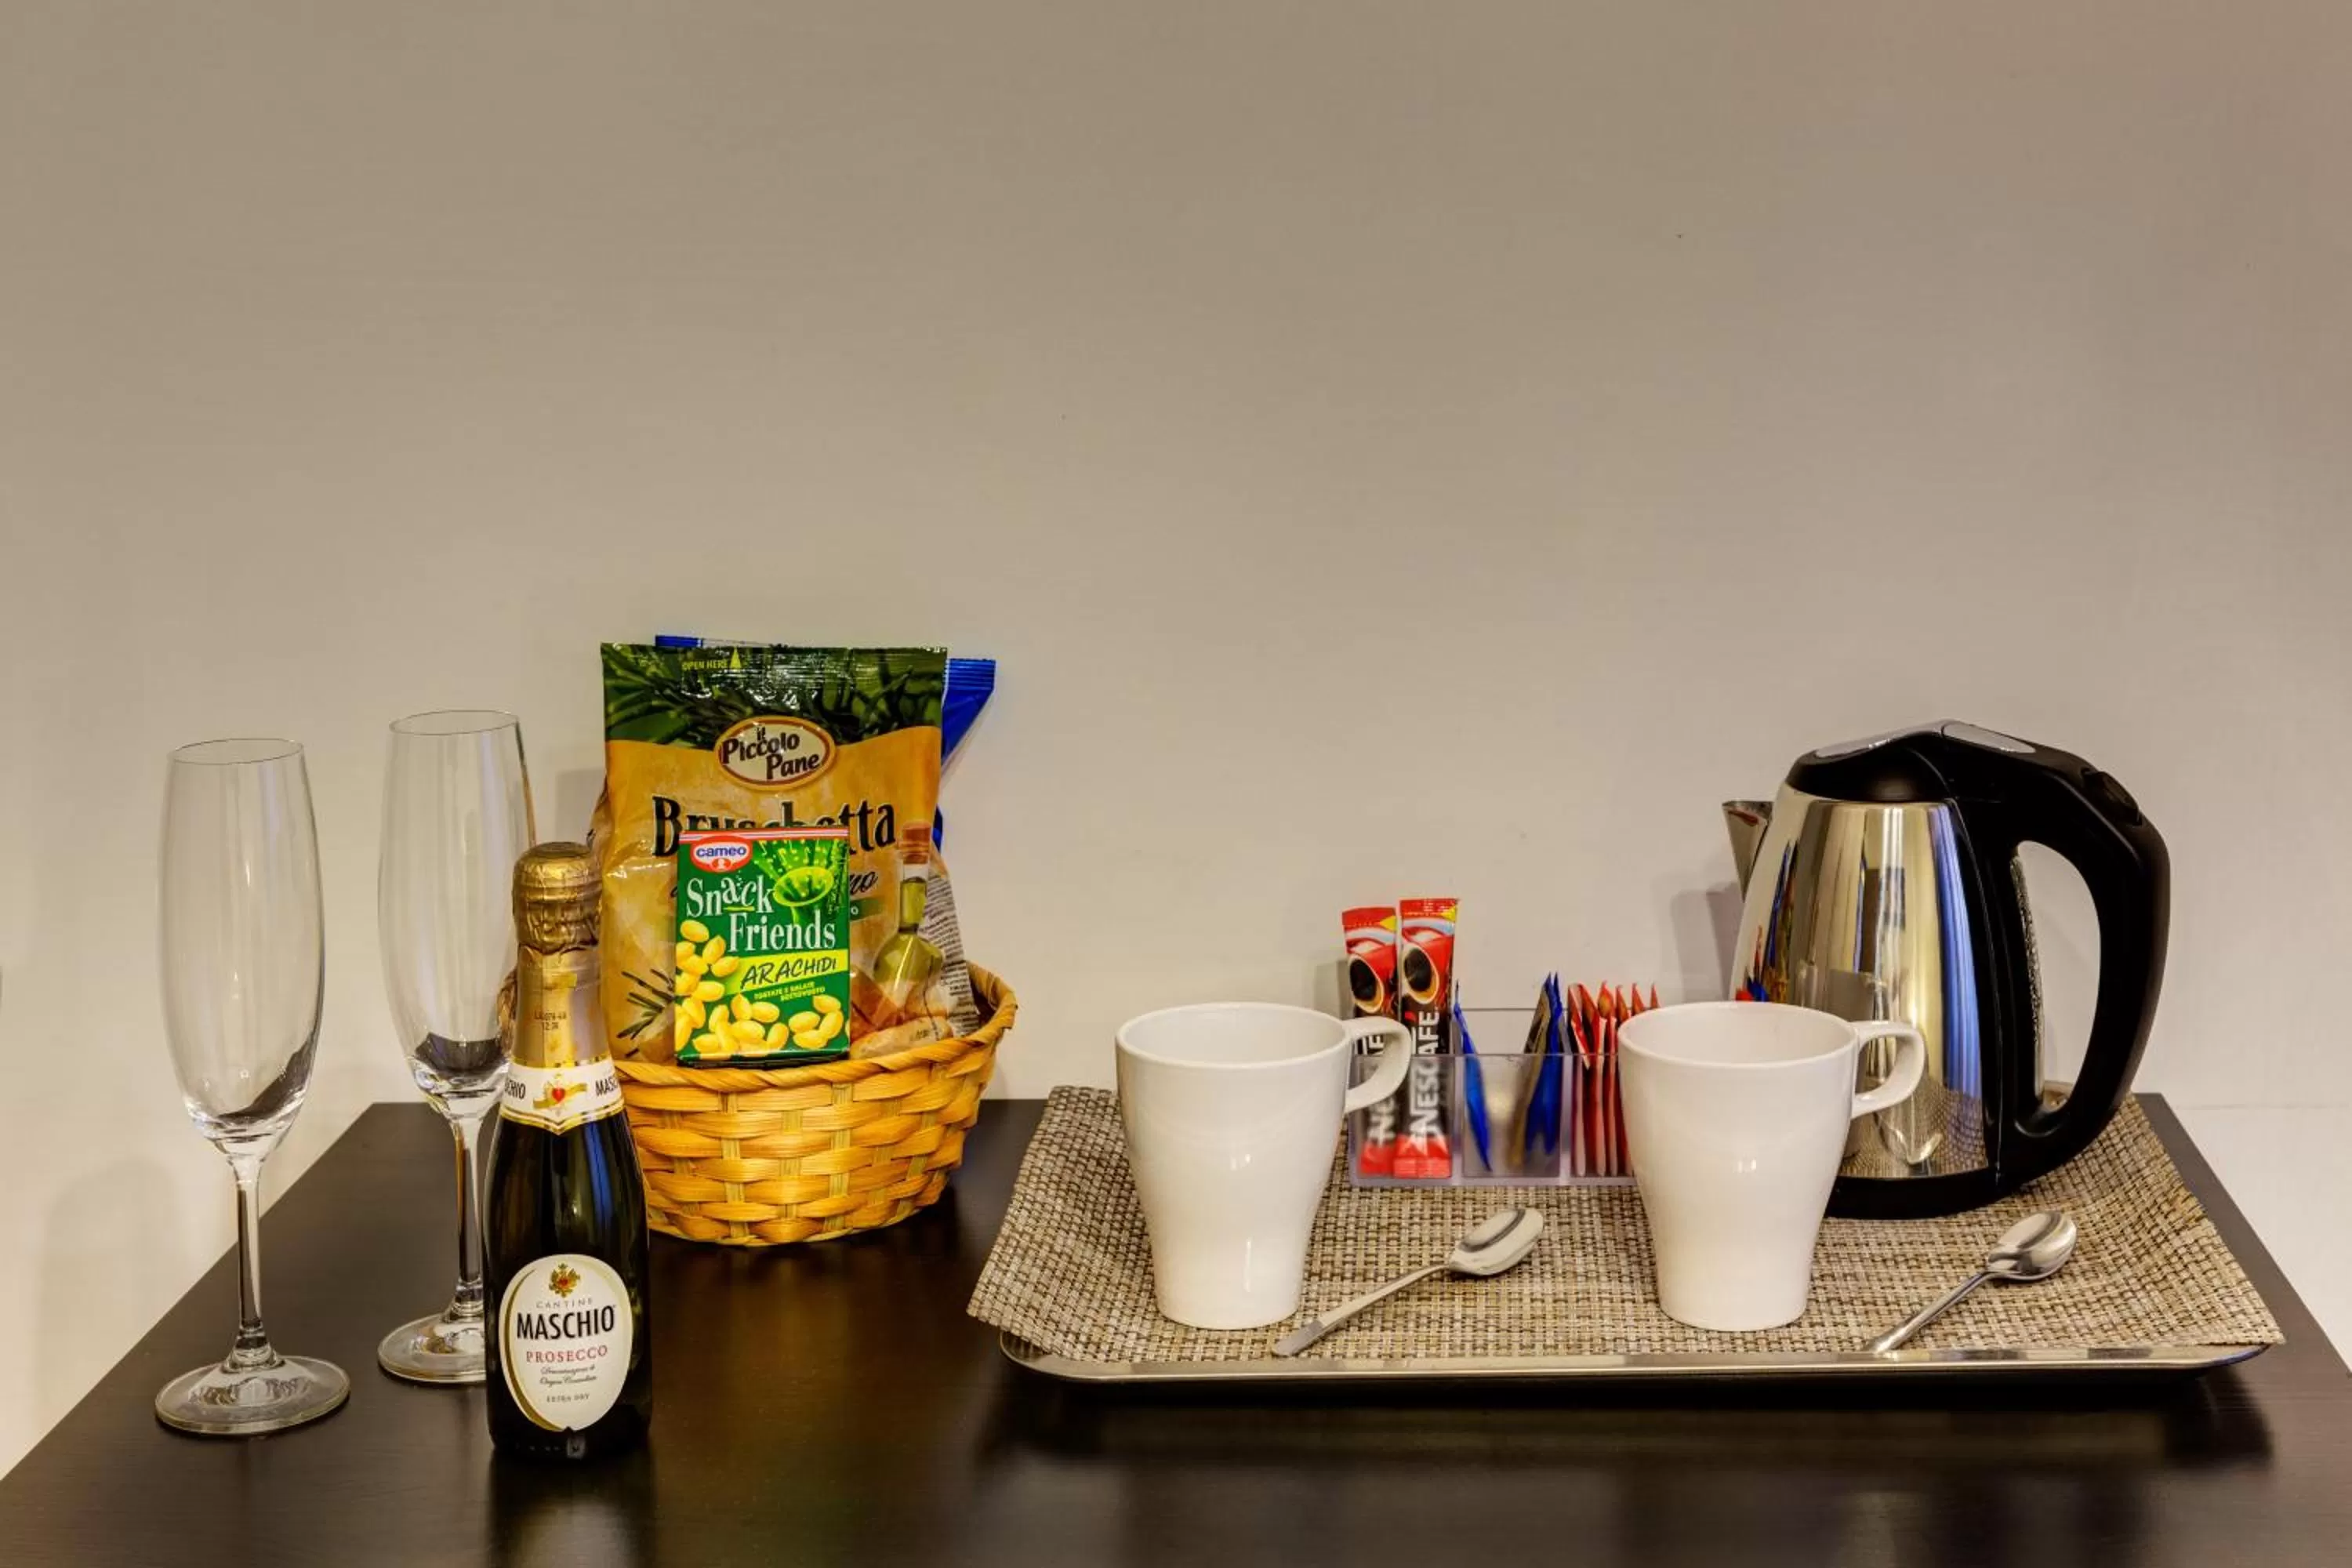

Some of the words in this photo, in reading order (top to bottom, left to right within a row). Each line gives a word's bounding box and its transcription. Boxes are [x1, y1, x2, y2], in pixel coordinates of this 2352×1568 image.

[706, 659, 728, 669] HERE
[722, 732, 800, 764] Piccolo
[766, 753, 820, 780] Pane
[695, 844, 748, 858] cameo
[686, 874, 775, 918] Snack
[728, 908, 837, 953] Friends
[740, 956, 837, 990] ARACHIDI
[535, 1298, 593, 1308] CANTINE
[516, 1305, 615, 1341] MASCHIO
[525, 1345, 608, 1363] PROSECCO
